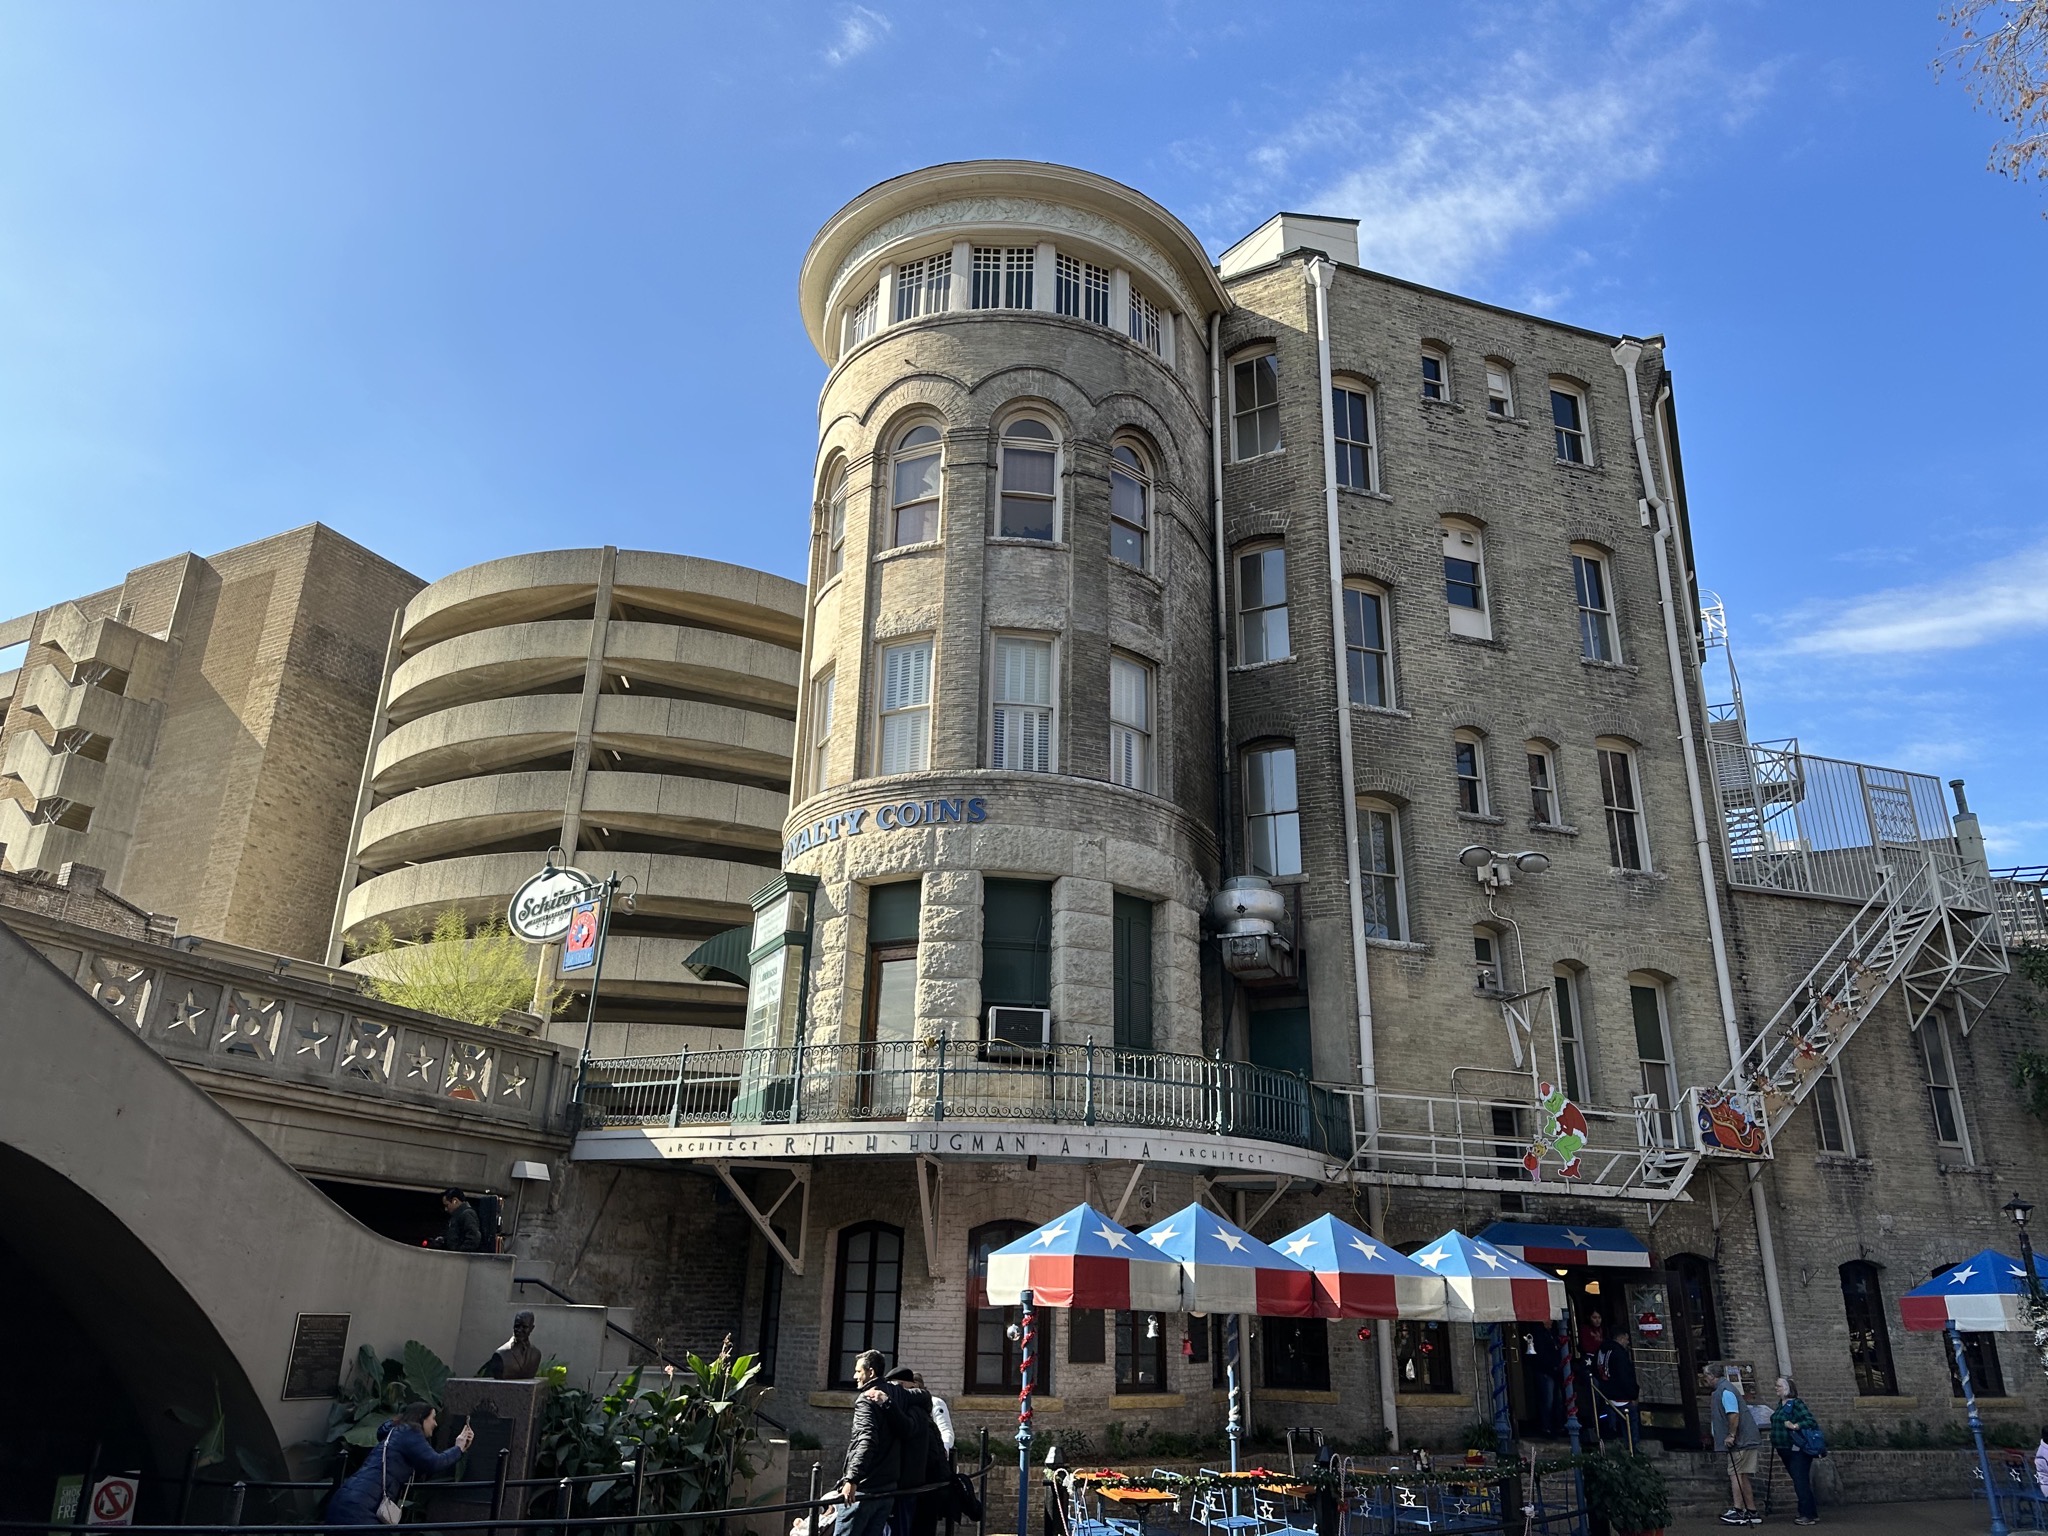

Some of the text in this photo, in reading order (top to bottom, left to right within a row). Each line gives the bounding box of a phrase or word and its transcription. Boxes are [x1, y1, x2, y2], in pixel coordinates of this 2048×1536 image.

[875, 797, 988, 830] COINS
[535, 918, 556, 930] SINCE
[668, 1141, 758, 1153] ARCHITECT
[785, 1137, 795, 1153] R
[824, 1136, 835, 1153] H
[866, 1135, 878, 1152] H
[910, 1134, 1025, 1152] HUGMAN
[1061, 1138, 1070, 1155] A
[1142, 1141, 1150, 1158] A
[1179, 1149, 1262, 1164] ARCHITECT
